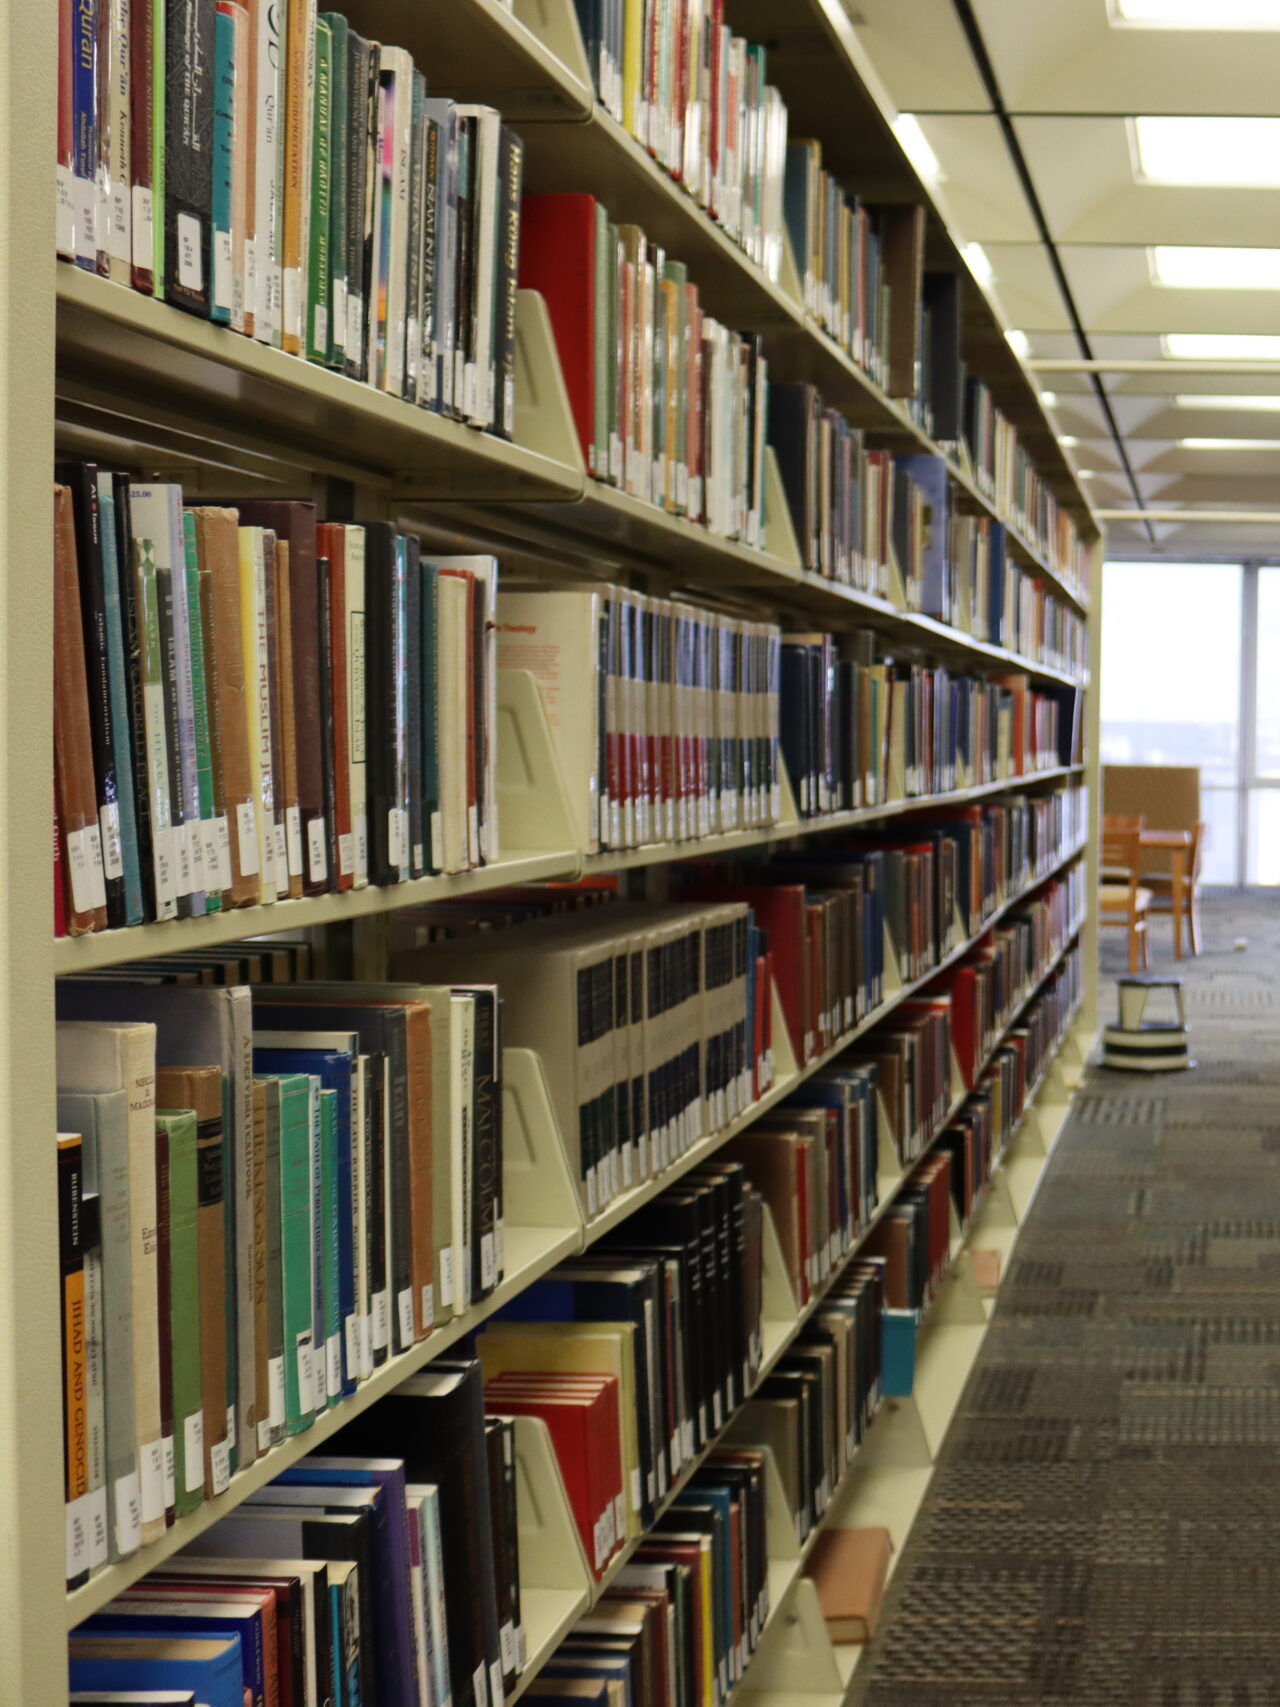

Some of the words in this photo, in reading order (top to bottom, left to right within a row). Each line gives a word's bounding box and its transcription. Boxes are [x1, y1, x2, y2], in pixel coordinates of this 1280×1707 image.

[79, 0, 96, 69] Quran
[184, 72, 192, 94] THE
[319, 74, 327, 131] MANUAL
[119, 110, 128, 169] Kenneth
[319, 139, 327, 156] OF
[508, 144, 521, 201] Hans
[425, 183, 435, 233] ISLAM
[505, 277, 517, 340] Islam
[90, 484, 97, 500] At
[128, 597, 139, 659] ISLAM
[258, 608, 267, 653] THE
[167, 637, 175, 682] ISLAM
[100, 657, 110, 746] Fundamentalism
[132, 684, 143, 755] WORLD
[259, 665, 269, 754] MUSLIM
[260, 764, 272, 812] JESU
[315, 1166, 321, 1181] OF
[477, 1075, 493, 1234] MALCOLM
[71, 1173, 79, 1246] RUBENSTEIN
[72, 1299, 82, 1354] JIHAD
[73, 1362, 83, 1402] AND
[74, 1408, 85, 1496] GENOCID
